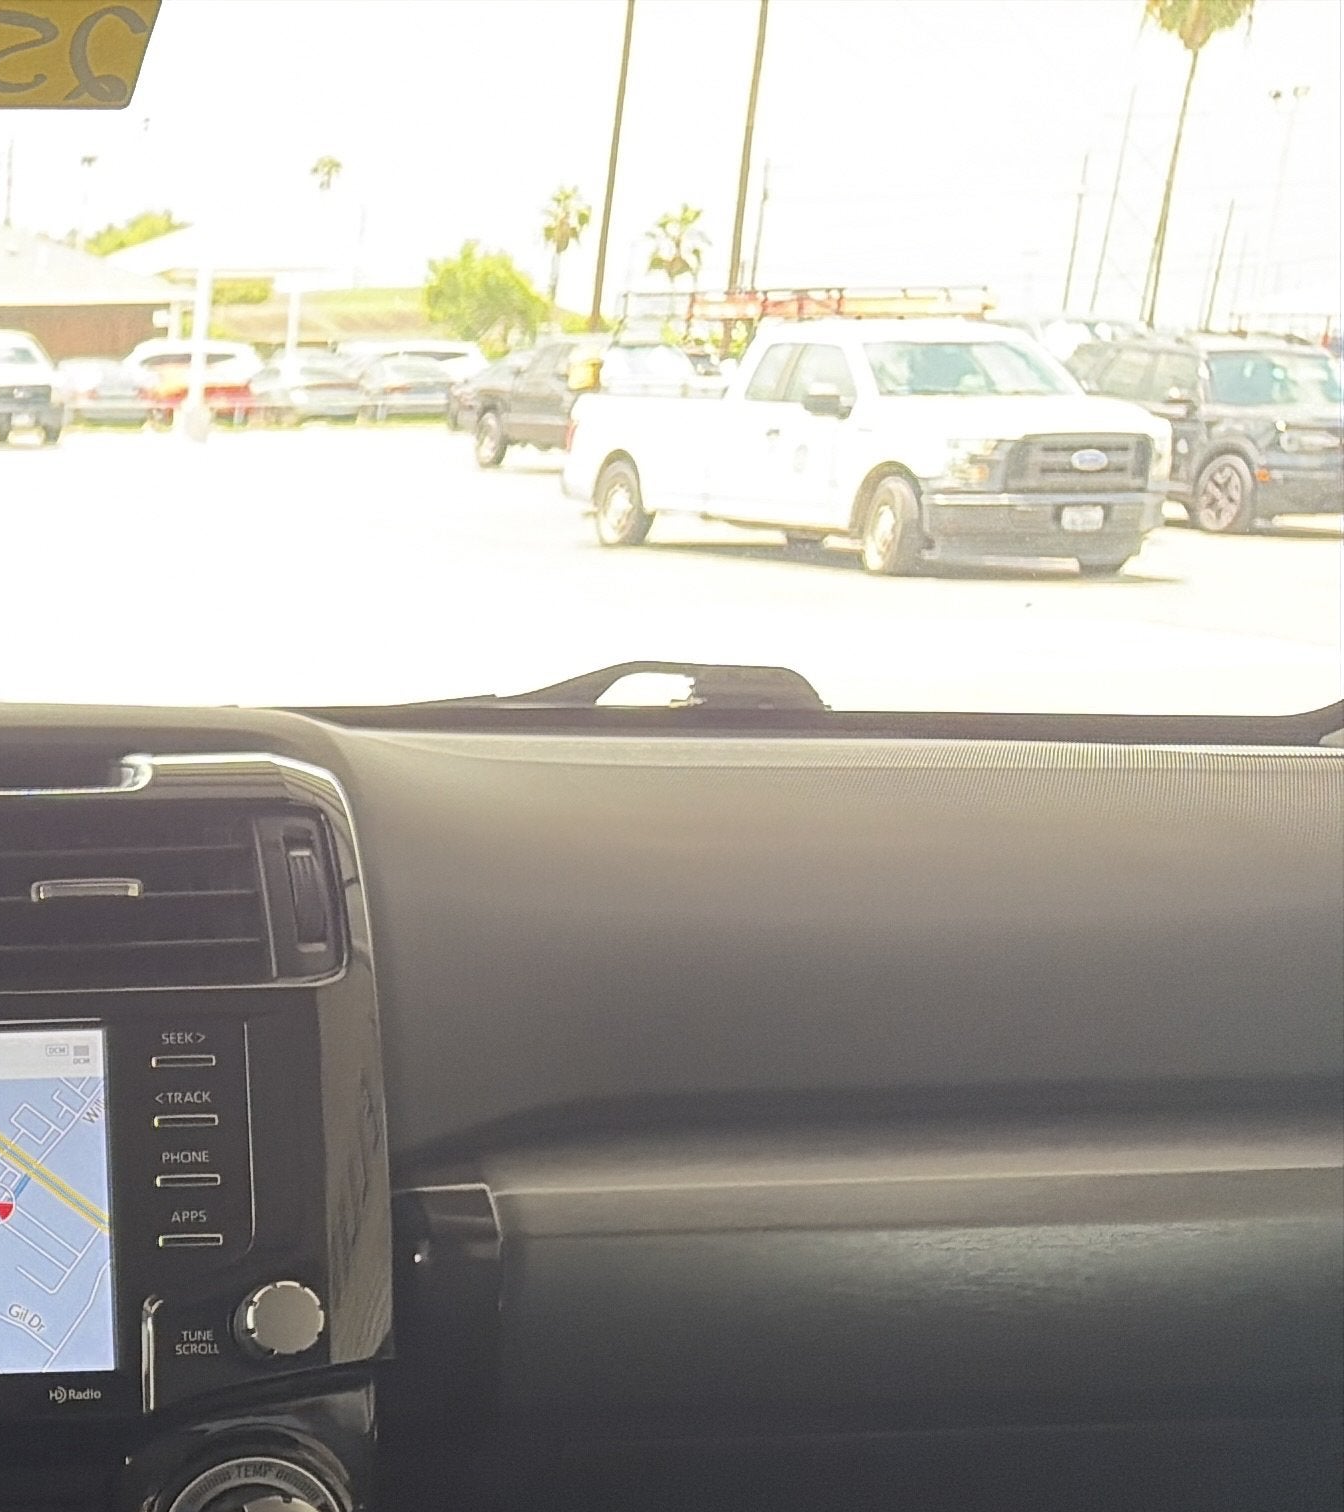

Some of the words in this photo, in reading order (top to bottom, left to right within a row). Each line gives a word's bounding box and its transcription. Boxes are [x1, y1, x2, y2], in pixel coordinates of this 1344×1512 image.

[162, 1150, 210, 1164] PHONE
[171, 1209, 208, 1224] APPS
[8, 1303, 29, 1322] Gil
[28, 1313, 46, 1333] Dr
[181, 1329, 215, 1342] TUNE
[175, 1343, 220, 1356] SCROLL
[69, 1387, 102, 1400] Radio
[237, 1462, 273, 1479] TEMP
